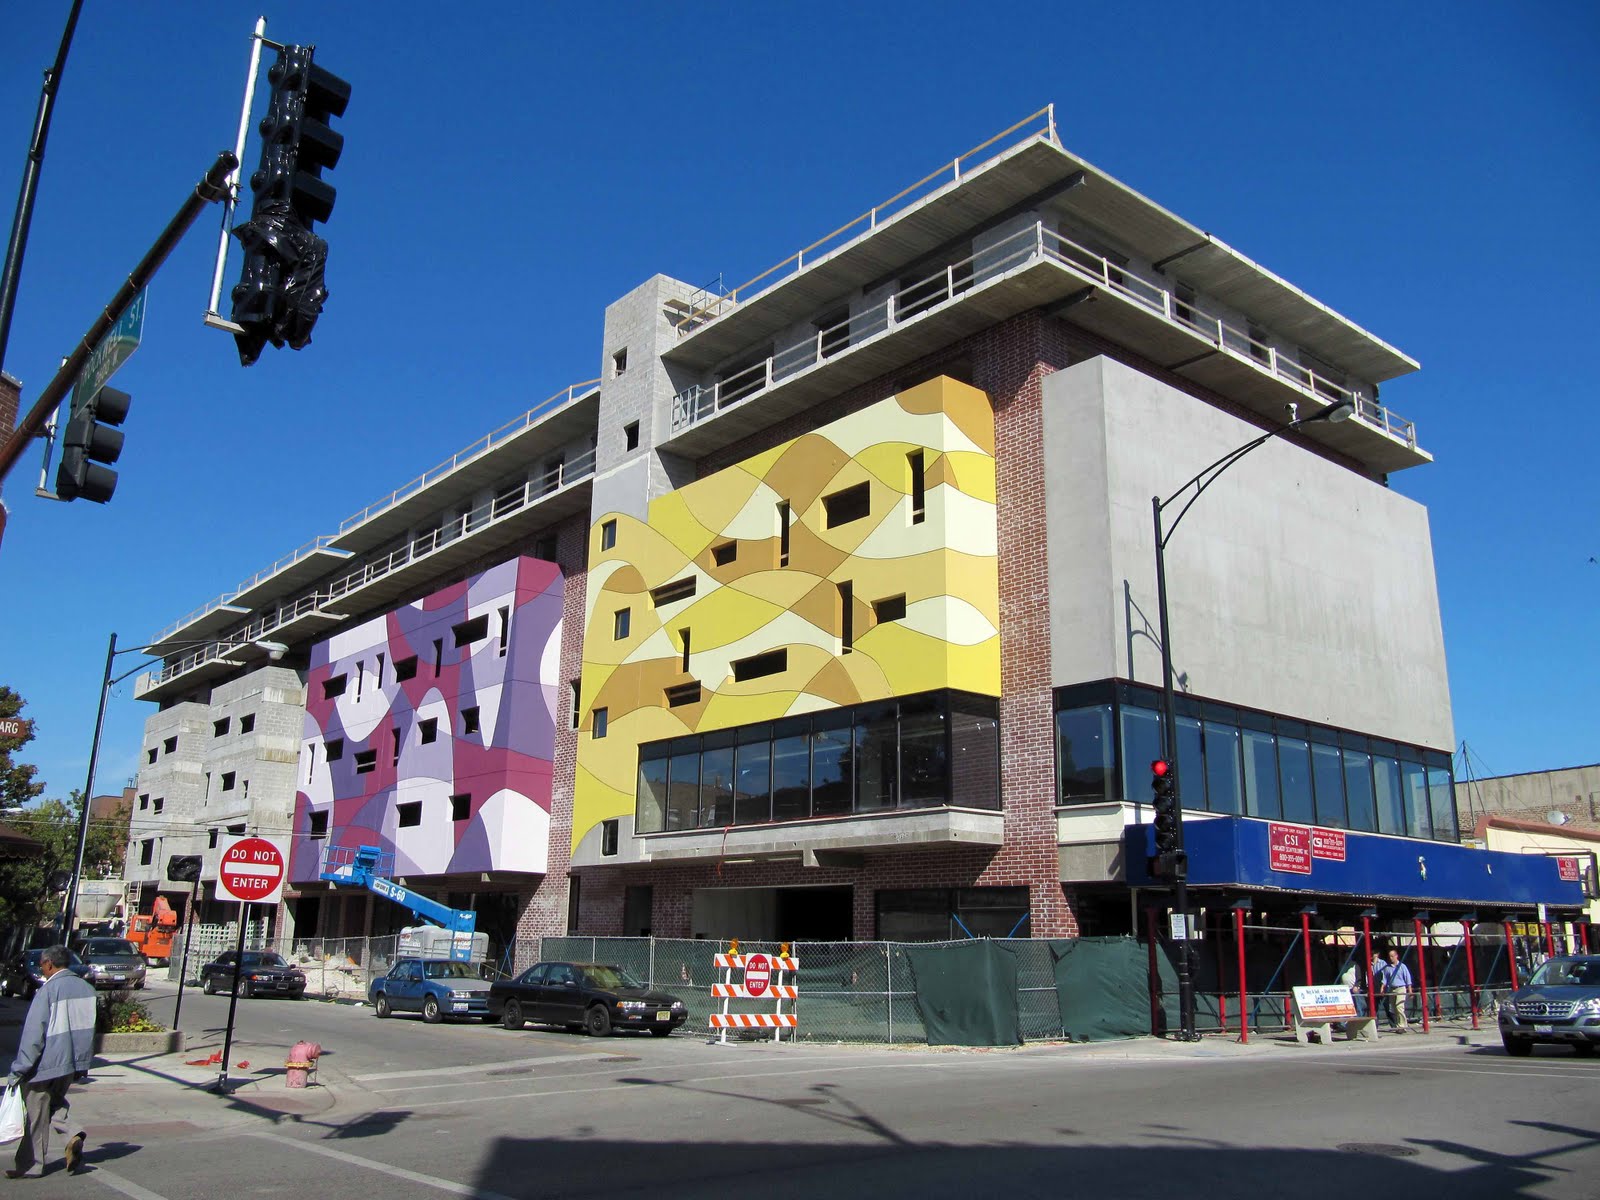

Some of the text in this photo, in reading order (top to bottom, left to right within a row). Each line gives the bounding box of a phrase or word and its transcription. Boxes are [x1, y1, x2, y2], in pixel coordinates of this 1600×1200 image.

[0, 721, 19, 734] ARG
[1284, 834, 1298, 846] CSI
[231, 848, 277, 861] DO NOT
[232, 877, 269, 889] ENTER
[389, 886, 406, 902] S-60
[758, 962, 767, 970] NOT
[749, 981, 764, 989] ENTER
